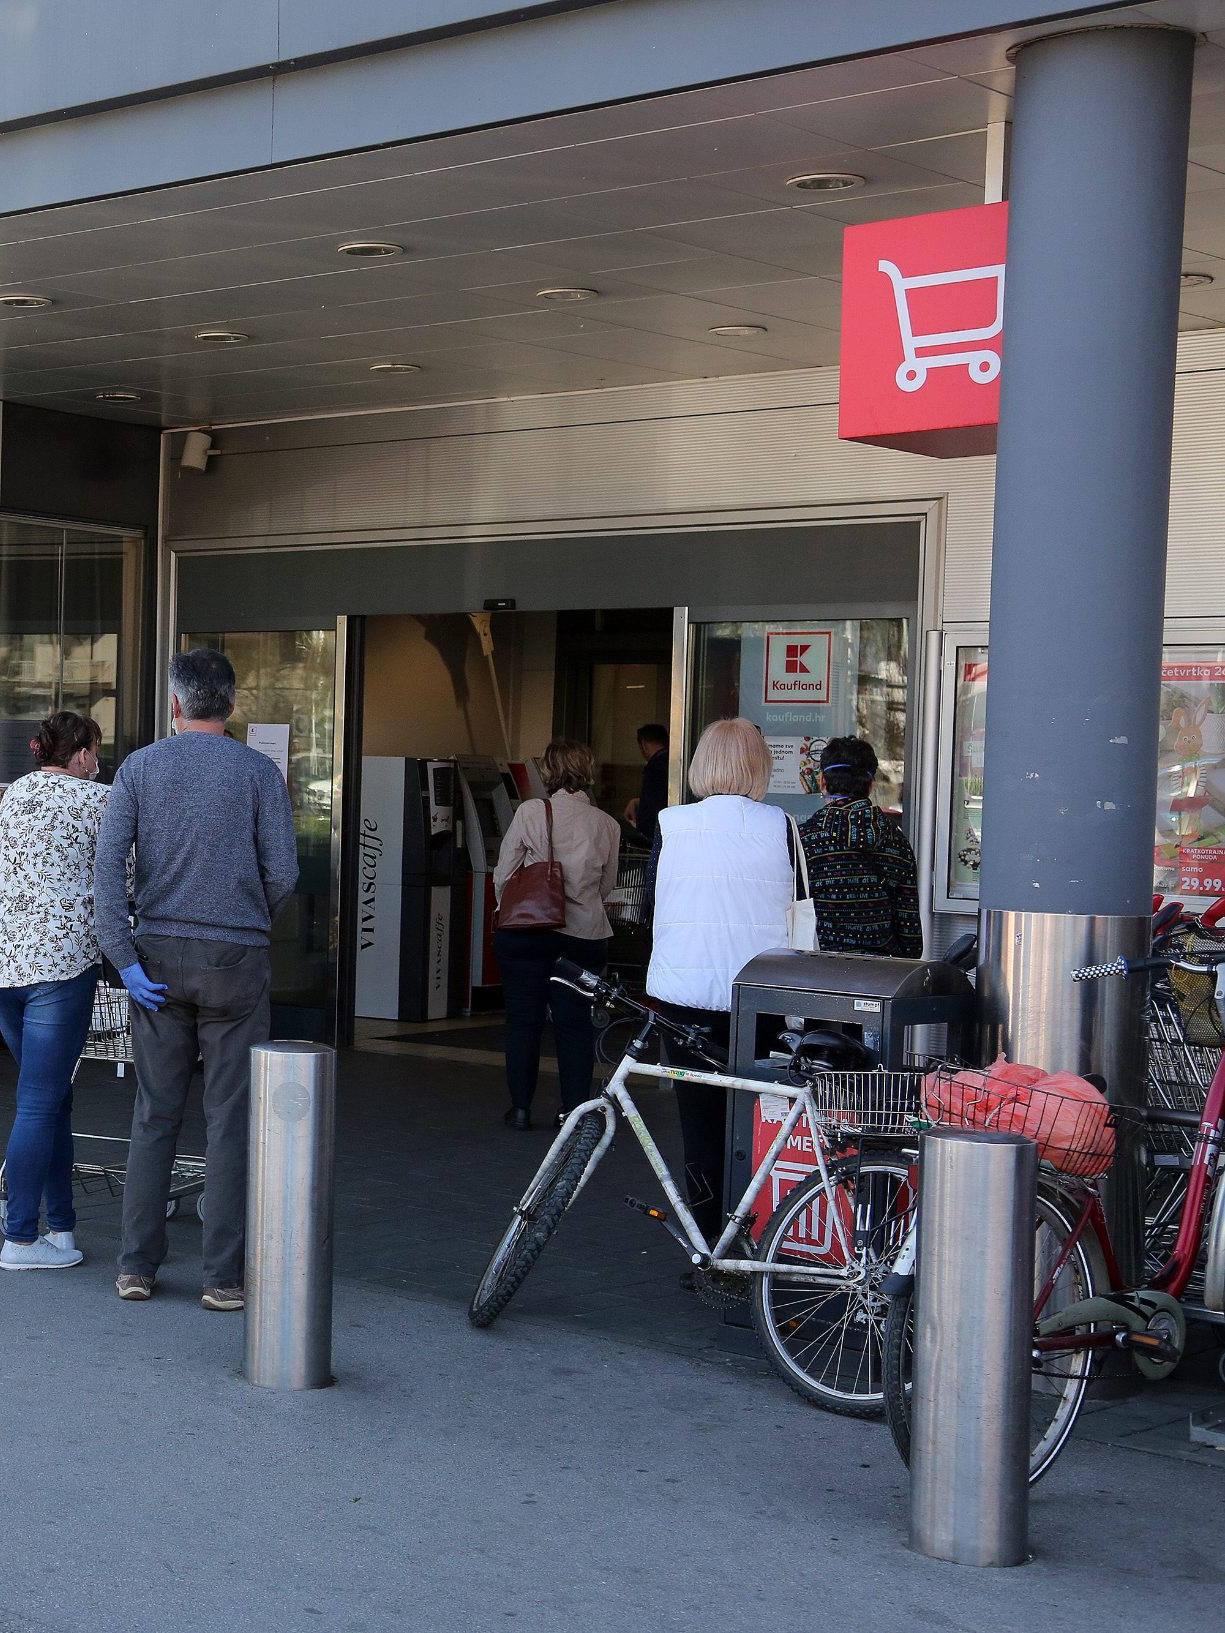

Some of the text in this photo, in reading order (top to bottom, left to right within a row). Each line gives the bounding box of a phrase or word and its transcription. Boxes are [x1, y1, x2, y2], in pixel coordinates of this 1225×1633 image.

[1161, 666, 1211, 676] četvrtka
[772, 680, 822, 691] Kaufland
[766, 712, 826, 722] kaufland.hr
[1181, 876, 1223, 892] 29.99
